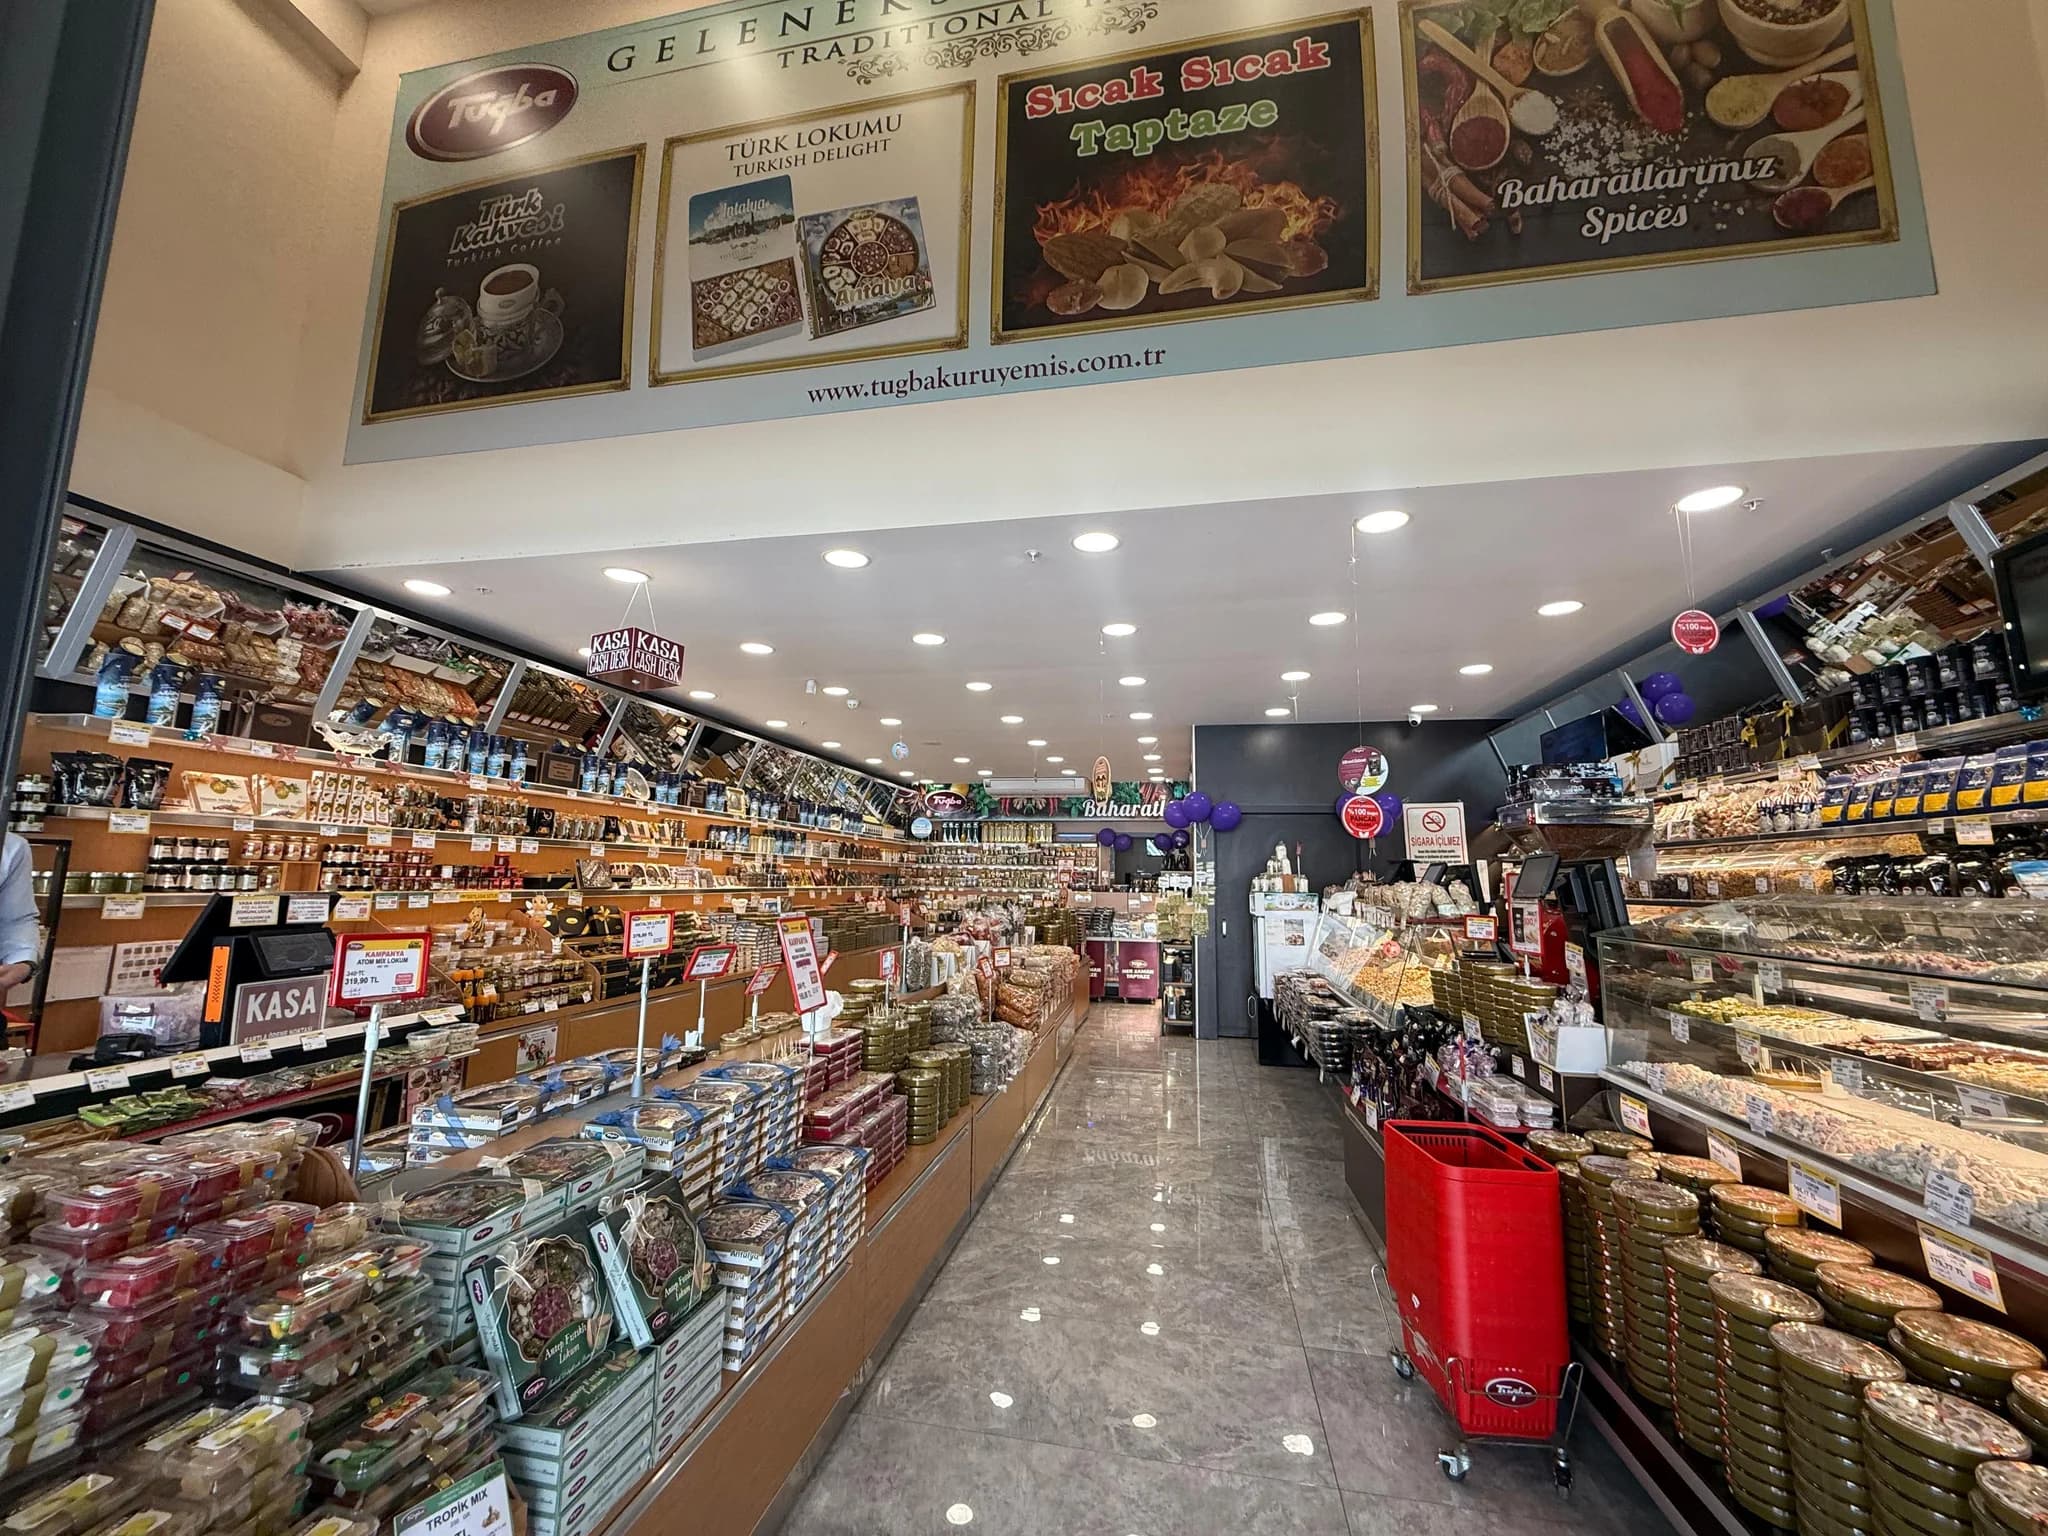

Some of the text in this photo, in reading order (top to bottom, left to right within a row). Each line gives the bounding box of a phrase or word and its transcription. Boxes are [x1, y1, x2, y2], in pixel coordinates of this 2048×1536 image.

[607, 0, 944, 72] GELENEK
[776, 1, 1053, 68] TRADITIONAL
[1026, 36, 1331, 119] Sıcak Sıcak
[726, 113, 903, 161] TÜRK LOKUMU
[1069, 100, 1279, 157] Taptaze
[733, 137, 892, 177] TURKISH DELIGHT
[1497, 156, 1777, 209] Baharatlarımız
[479, 187, 543, 226] Türk
[1580, 204, 1690, 244] Spices
[448, 202, 566, 255] Kahvesi
[446, 246, 503, 268] Turkish
[835, 273, 916, 306] Antalya
[808, 348, 1167, 404] www.tugbakuruyemis.com.tr
[589, 647, 630, 674] CASH DESK
[593, 630, 630, 653] KASA
[637, 631, 680, 663] KASA
[633, 649, 680, 683] CASH DESK
[1082, 799, 1165, 818] Baharatl
[1410, 835, 1435, 847] SİGARA
[245, 986, 316, 1024] KASA
[729, 1250, 759, 1260] Antalya
[544, 1340, 565, 1361] Antep
[558, 1343, 581, 1365] Lokum
[426, 1500, 469, 1531] TROPİK
[470, 1488, 488, 1506] MIX
